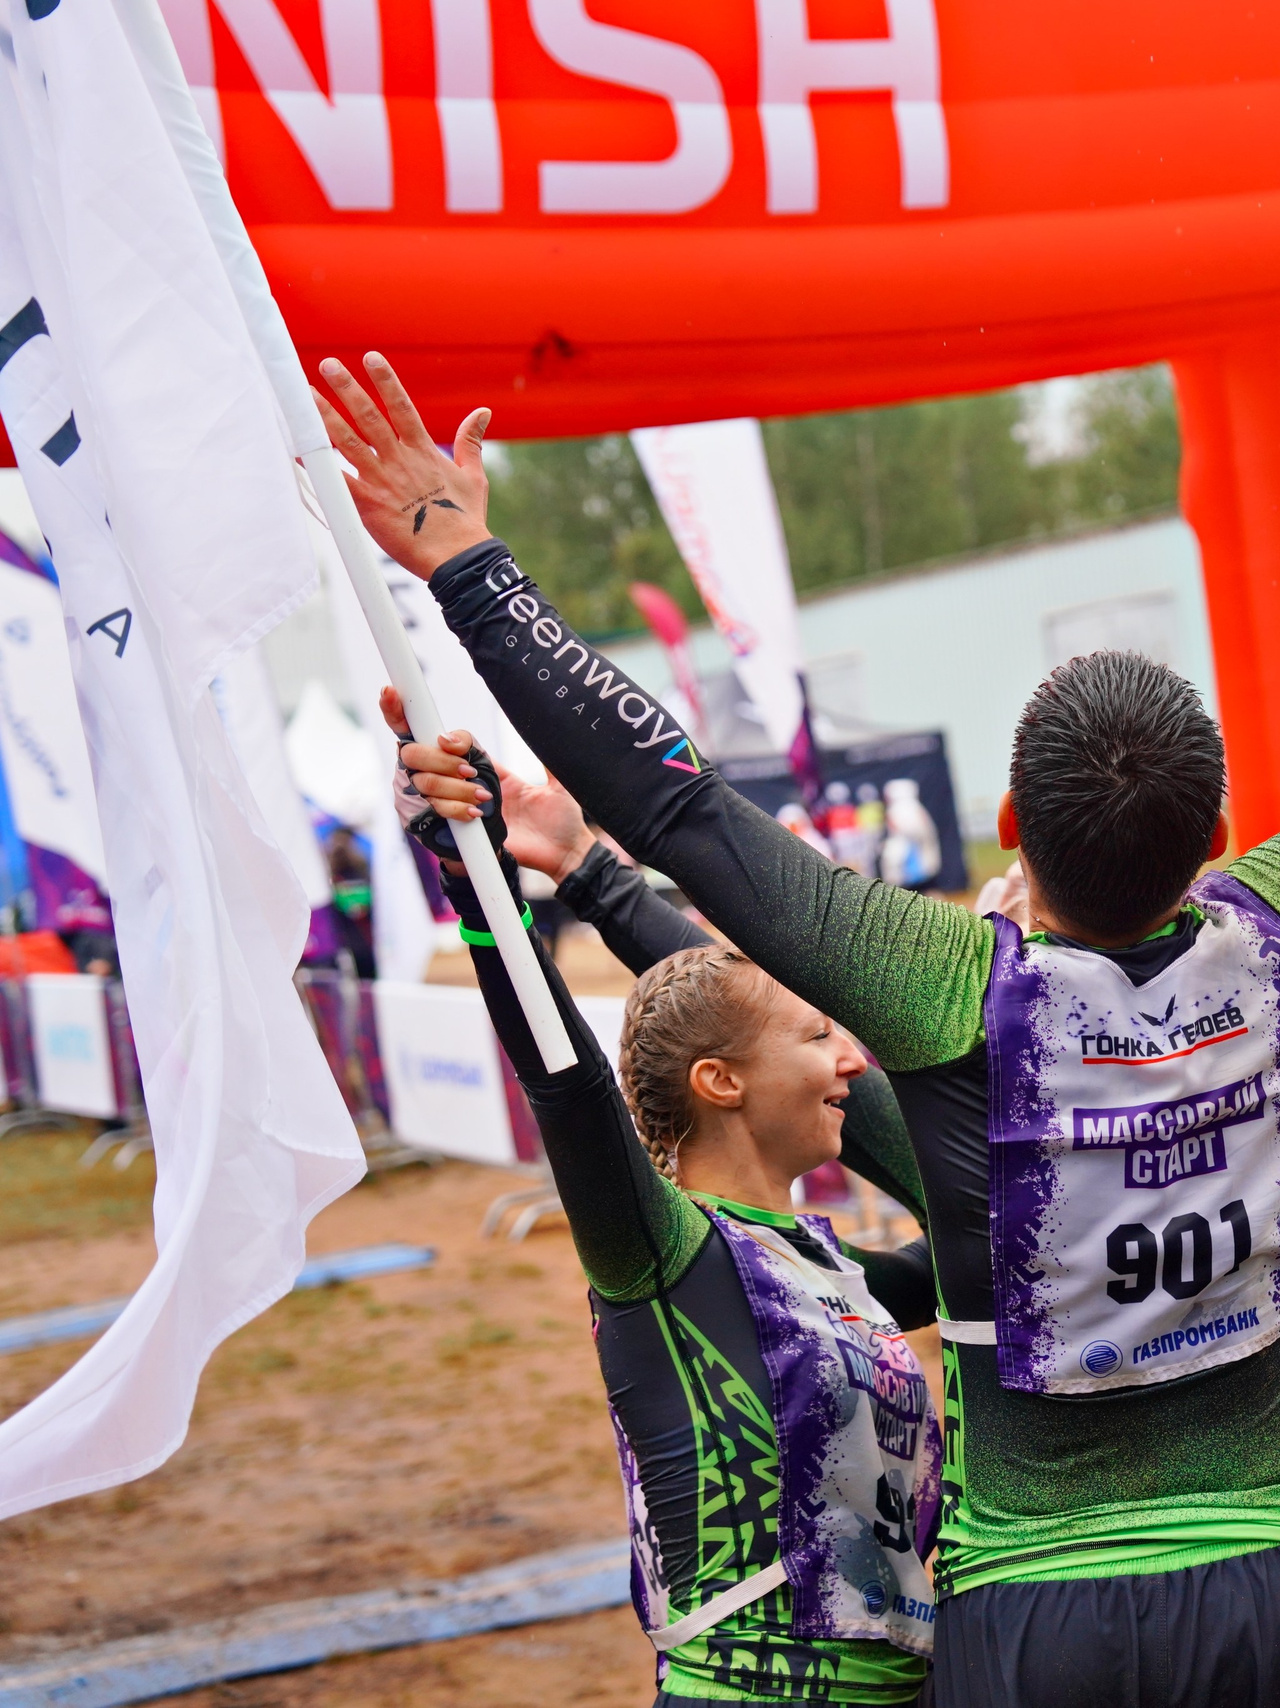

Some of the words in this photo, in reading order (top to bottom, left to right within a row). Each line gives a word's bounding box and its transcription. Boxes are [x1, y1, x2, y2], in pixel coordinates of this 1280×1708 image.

[505, 635, 601, 731] GLOBAL
[1080, 1034, 1165, 1058] ГОНКА
[1082, 1075, 1260, 1146] МАССОВЫЙ
[1131, 1131, 1217, 1185] СТАРТ
[1105, 1198, 1253, 1306] 901
[1131, 1306, 1261, 1365] ГАЗПРОМБАНК
